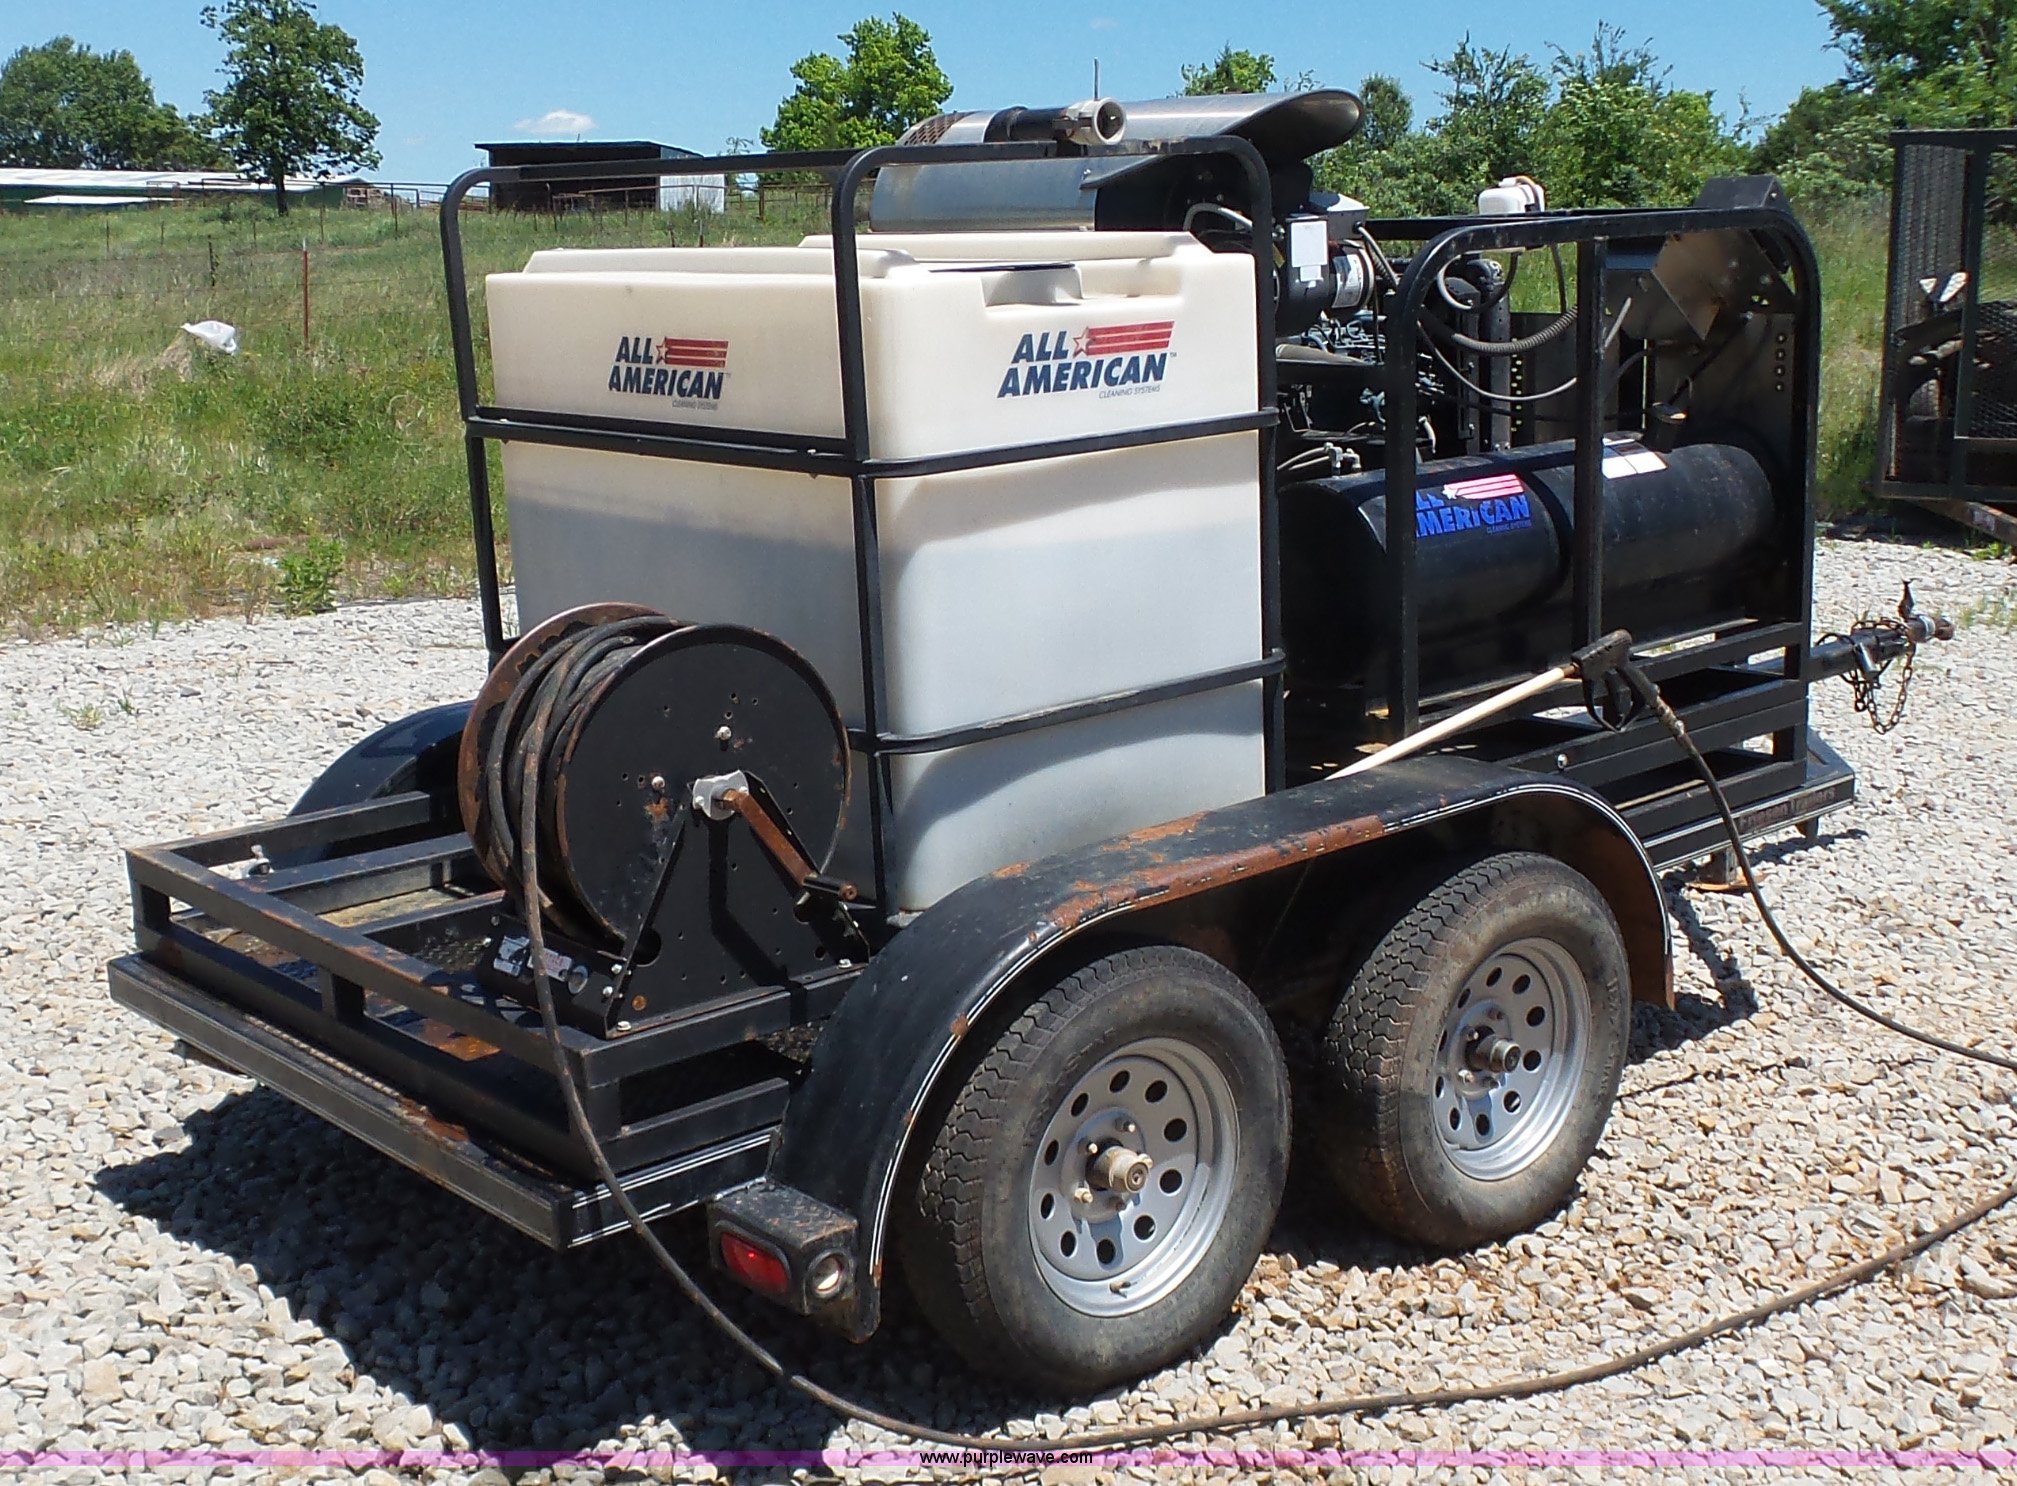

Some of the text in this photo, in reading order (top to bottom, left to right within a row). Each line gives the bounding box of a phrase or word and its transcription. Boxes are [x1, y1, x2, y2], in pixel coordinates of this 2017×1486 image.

[615, 336, 653, 365] ALL
[1011, 331, 1069, 364] ALL
[608, 365, 724, 400] AMERICAN
[997, 353, 1168, 398] AMERICAN
[1099, 385, 1160, 399] CLEANING SYSTEMS
[1416, 489, 1445, 511] LL
[1416, 494, 1530, 538] MERICAN
